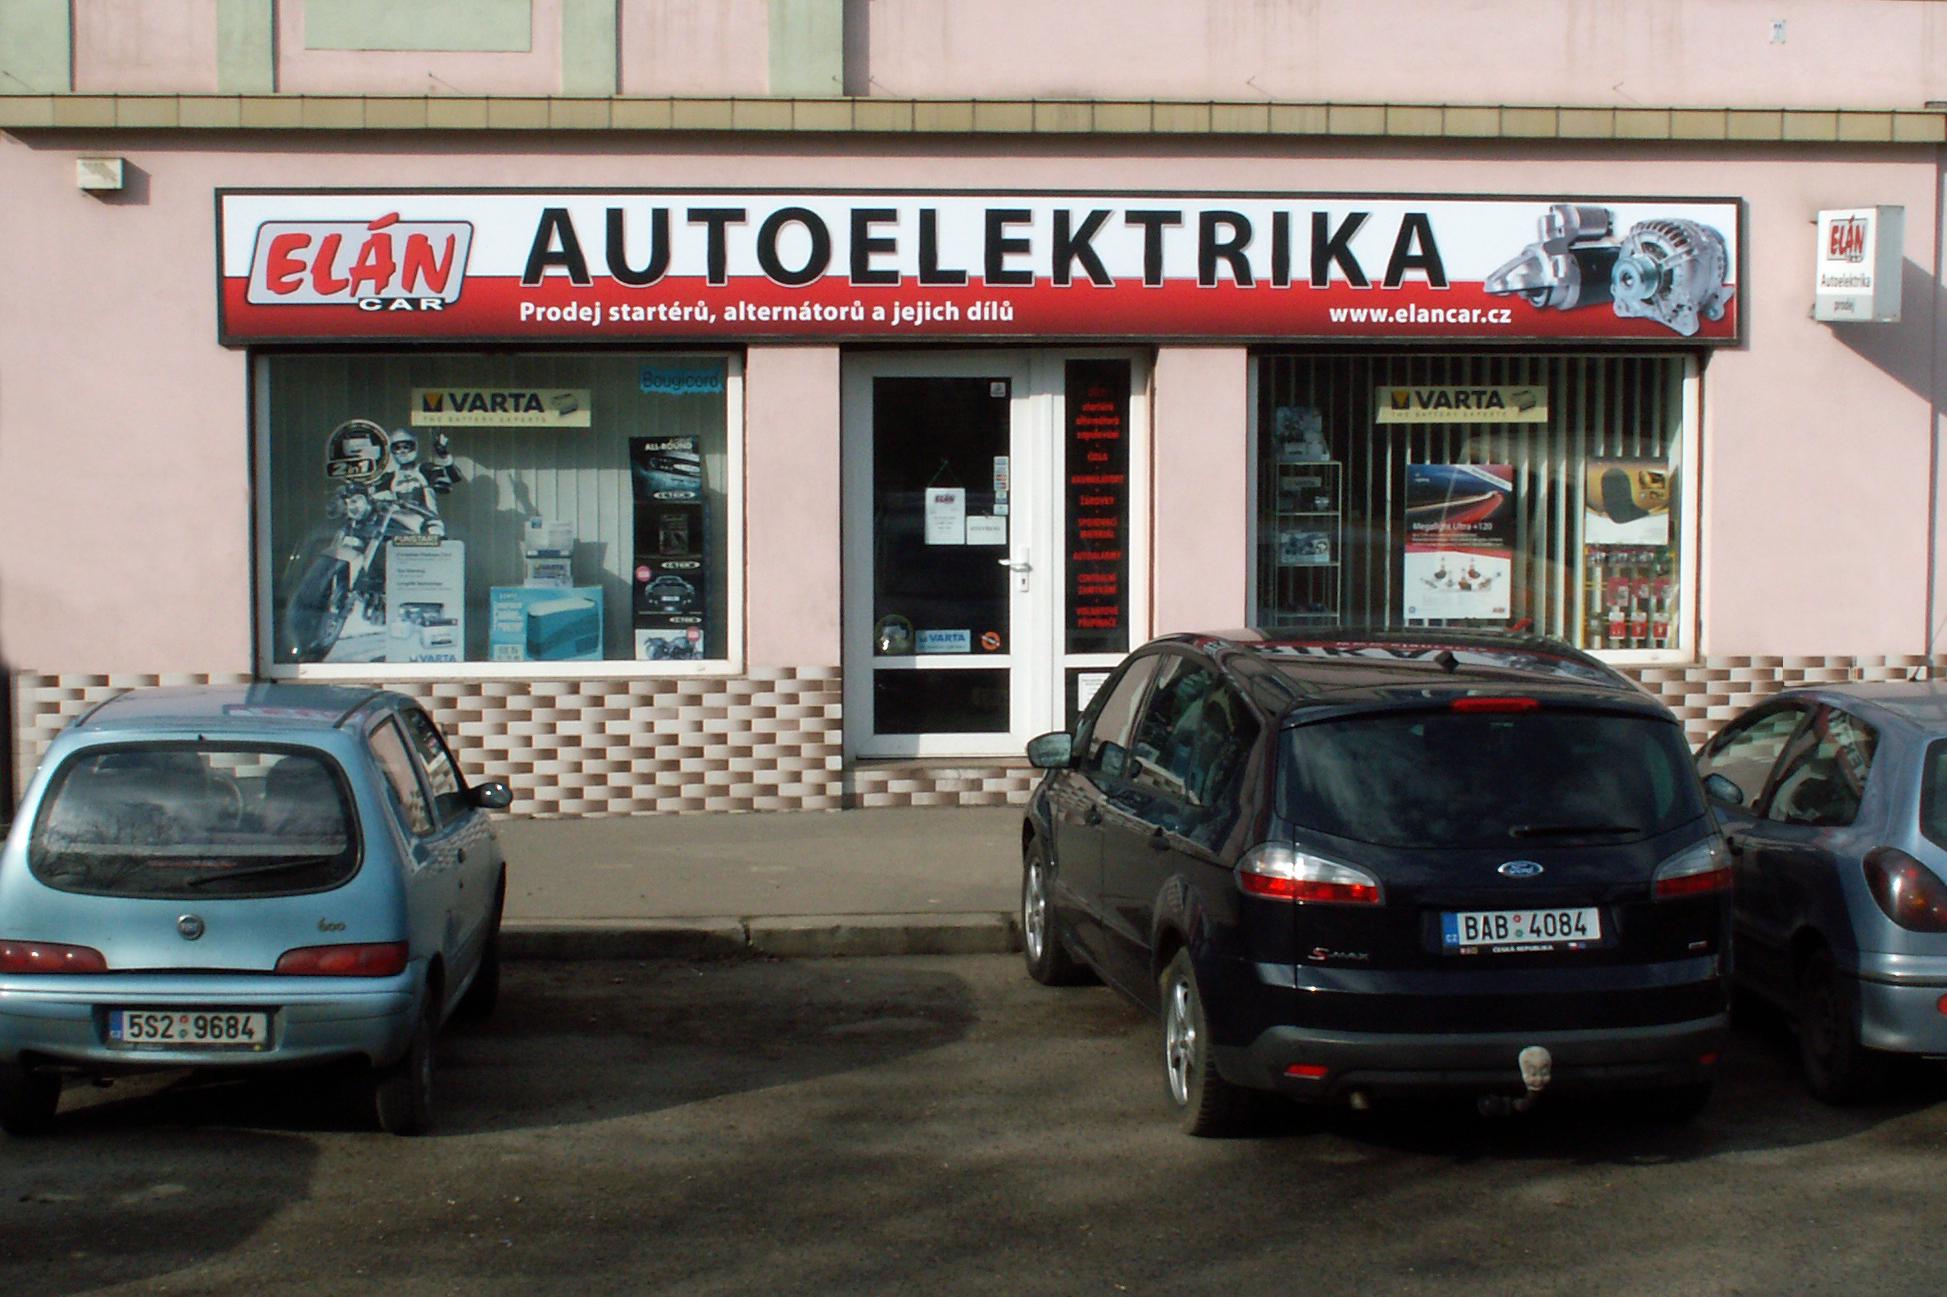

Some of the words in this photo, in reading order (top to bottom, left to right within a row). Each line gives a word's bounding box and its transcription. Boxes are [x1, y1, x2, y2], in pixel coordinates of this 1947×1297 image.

[1829, 214, 1866, 256] ELÁN
[266, 212, 456, 297] ELÁN
[521, 205, 1449, 290] AUTOELEKTRIKA
[1820, 273, 1871, 288] Autoelektrika
[357, 298, 444, 311] CAR
[519, 301, 602, 327] Prodej
[608, 300, 717, 324] startérů,
[723, 300, 865, 322] alternátorů
[871, 305, 886, 321] a
[890, 301, 960, 327] jejich
[966, 300, 1014, 322] dílů
[1328, 303, 1512, 324] www.elancar.cz
[449, 392, 545, 413] VARTA
[1414, 390, 1505, 410] VARTA
[928, 633, 966, 643] VARTA
[420, 654, 457, 663] VARTA
[1464, 915, 1509, 941] BAB
[1529, 911, 1588, 938] 4084
[128, 1014, 174, 1039] 5S2
[193, 1014, 256, 1040] 9684
